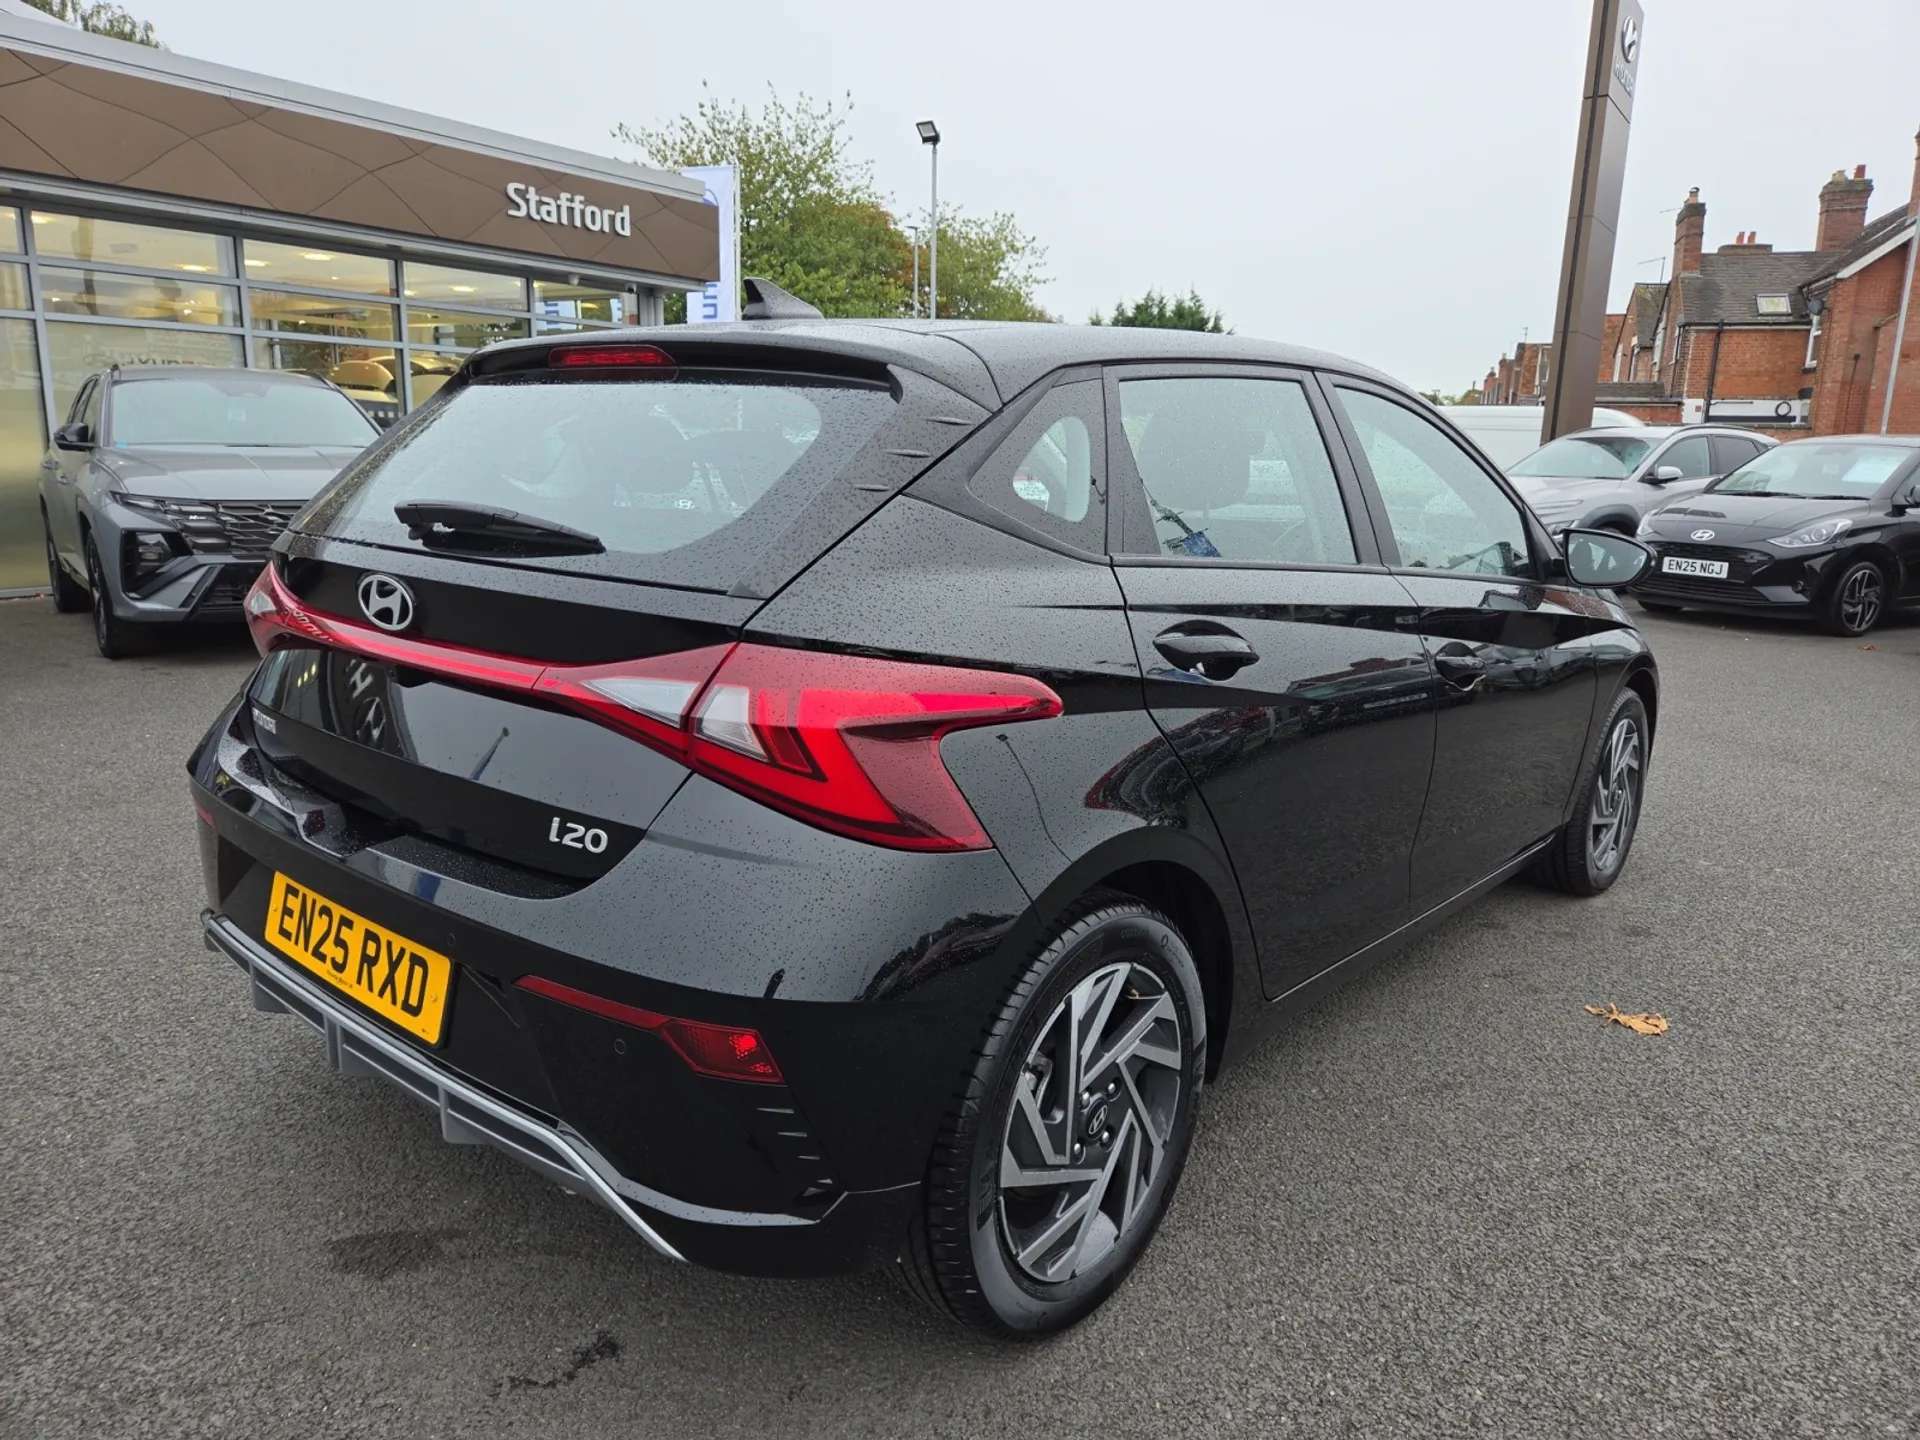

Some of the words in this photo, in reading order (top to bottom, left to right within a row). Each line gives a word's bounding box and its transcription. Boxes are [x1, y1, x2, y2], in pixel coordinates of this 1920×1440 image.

[506, 182, 631, 236] Stafford
[1667, 559, 1697, 573] EN25
[1699, 562, 1724, 575] NGJ
[278, 883, 355, 974] EN25
[356, 927, 430, 1018] RXD
